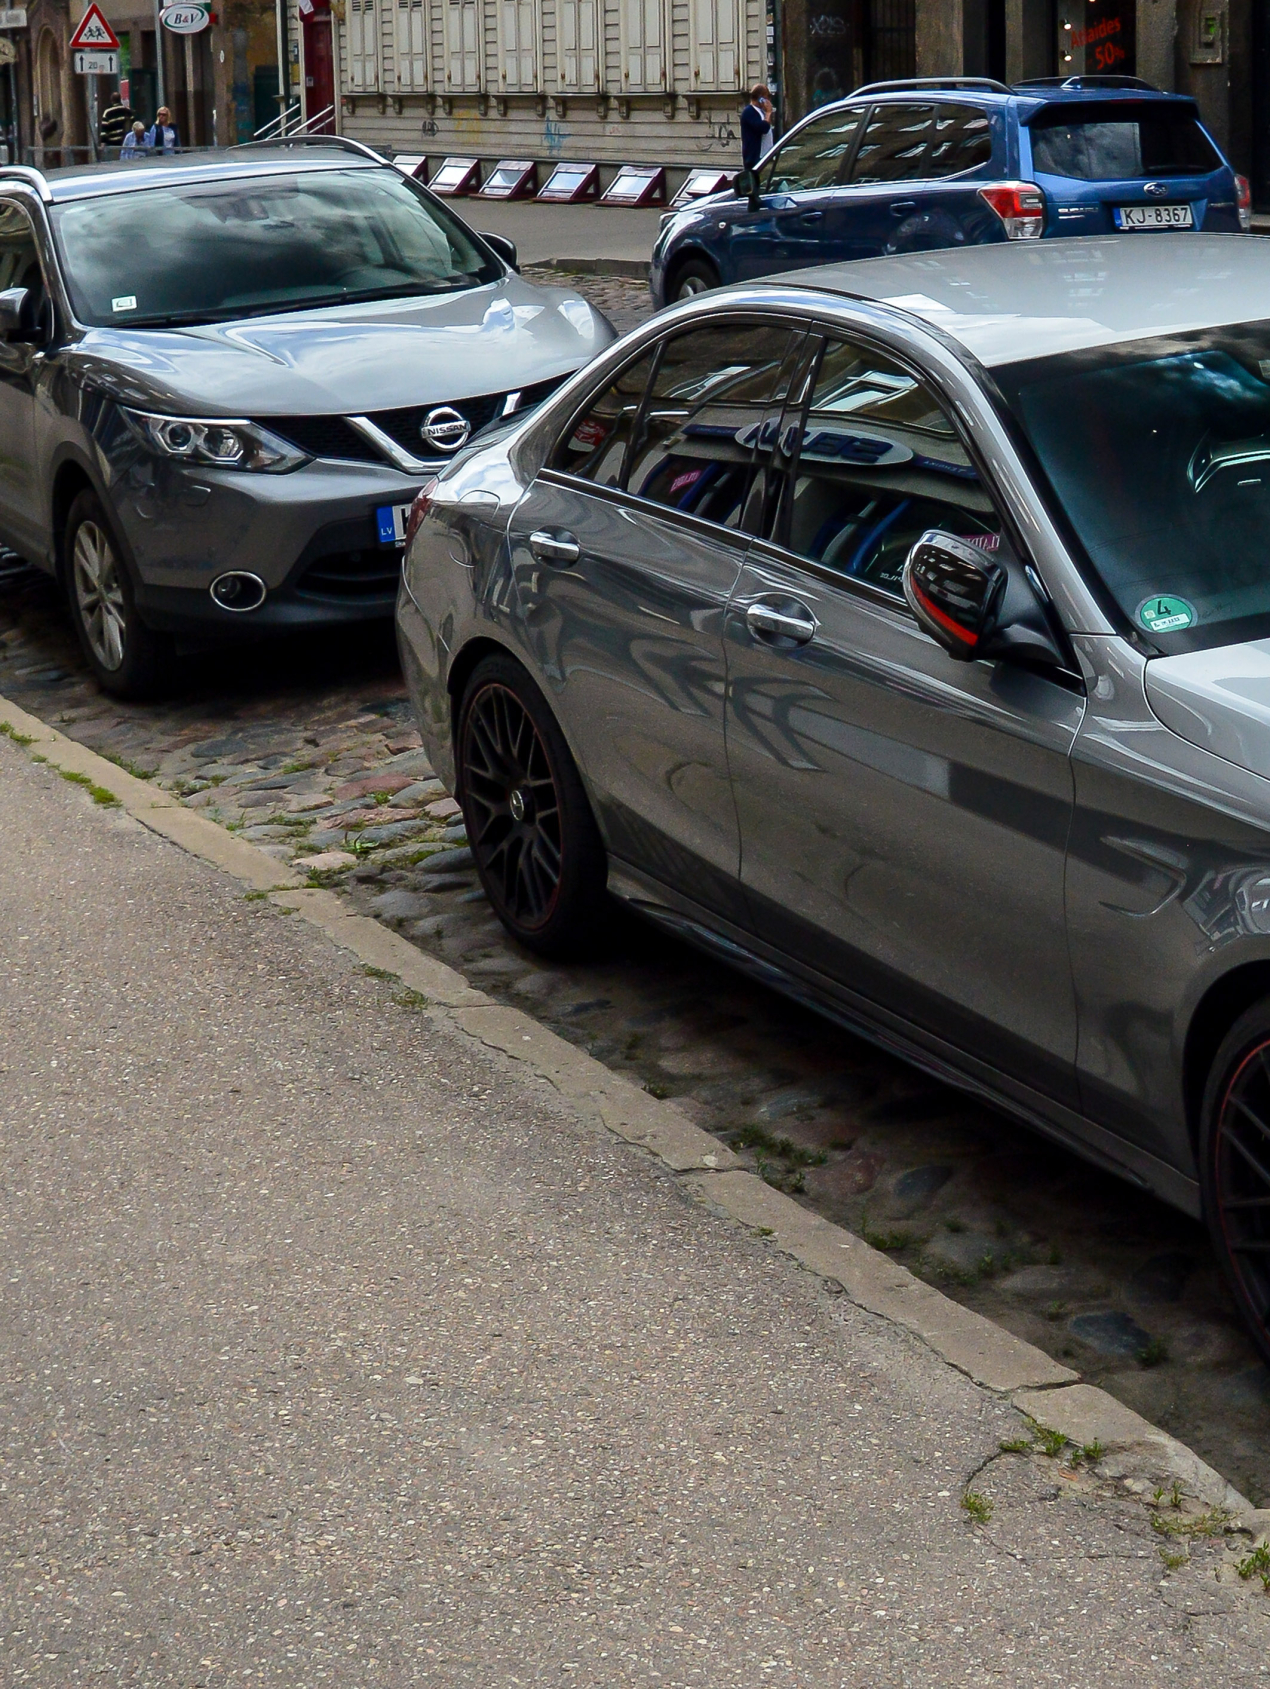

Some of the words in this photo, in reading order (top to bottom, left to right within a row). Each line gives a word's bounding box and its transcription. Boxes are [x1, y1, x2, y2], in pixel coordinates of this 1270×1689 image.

[174, 13, 199, 24] B&V
[1123, 206, 1189, 225] KJ-8367
[427, 422, 468, 437] NISSAN
[381, 527, 393, 537] LV
[1157, 600, 1171, 615] 4
